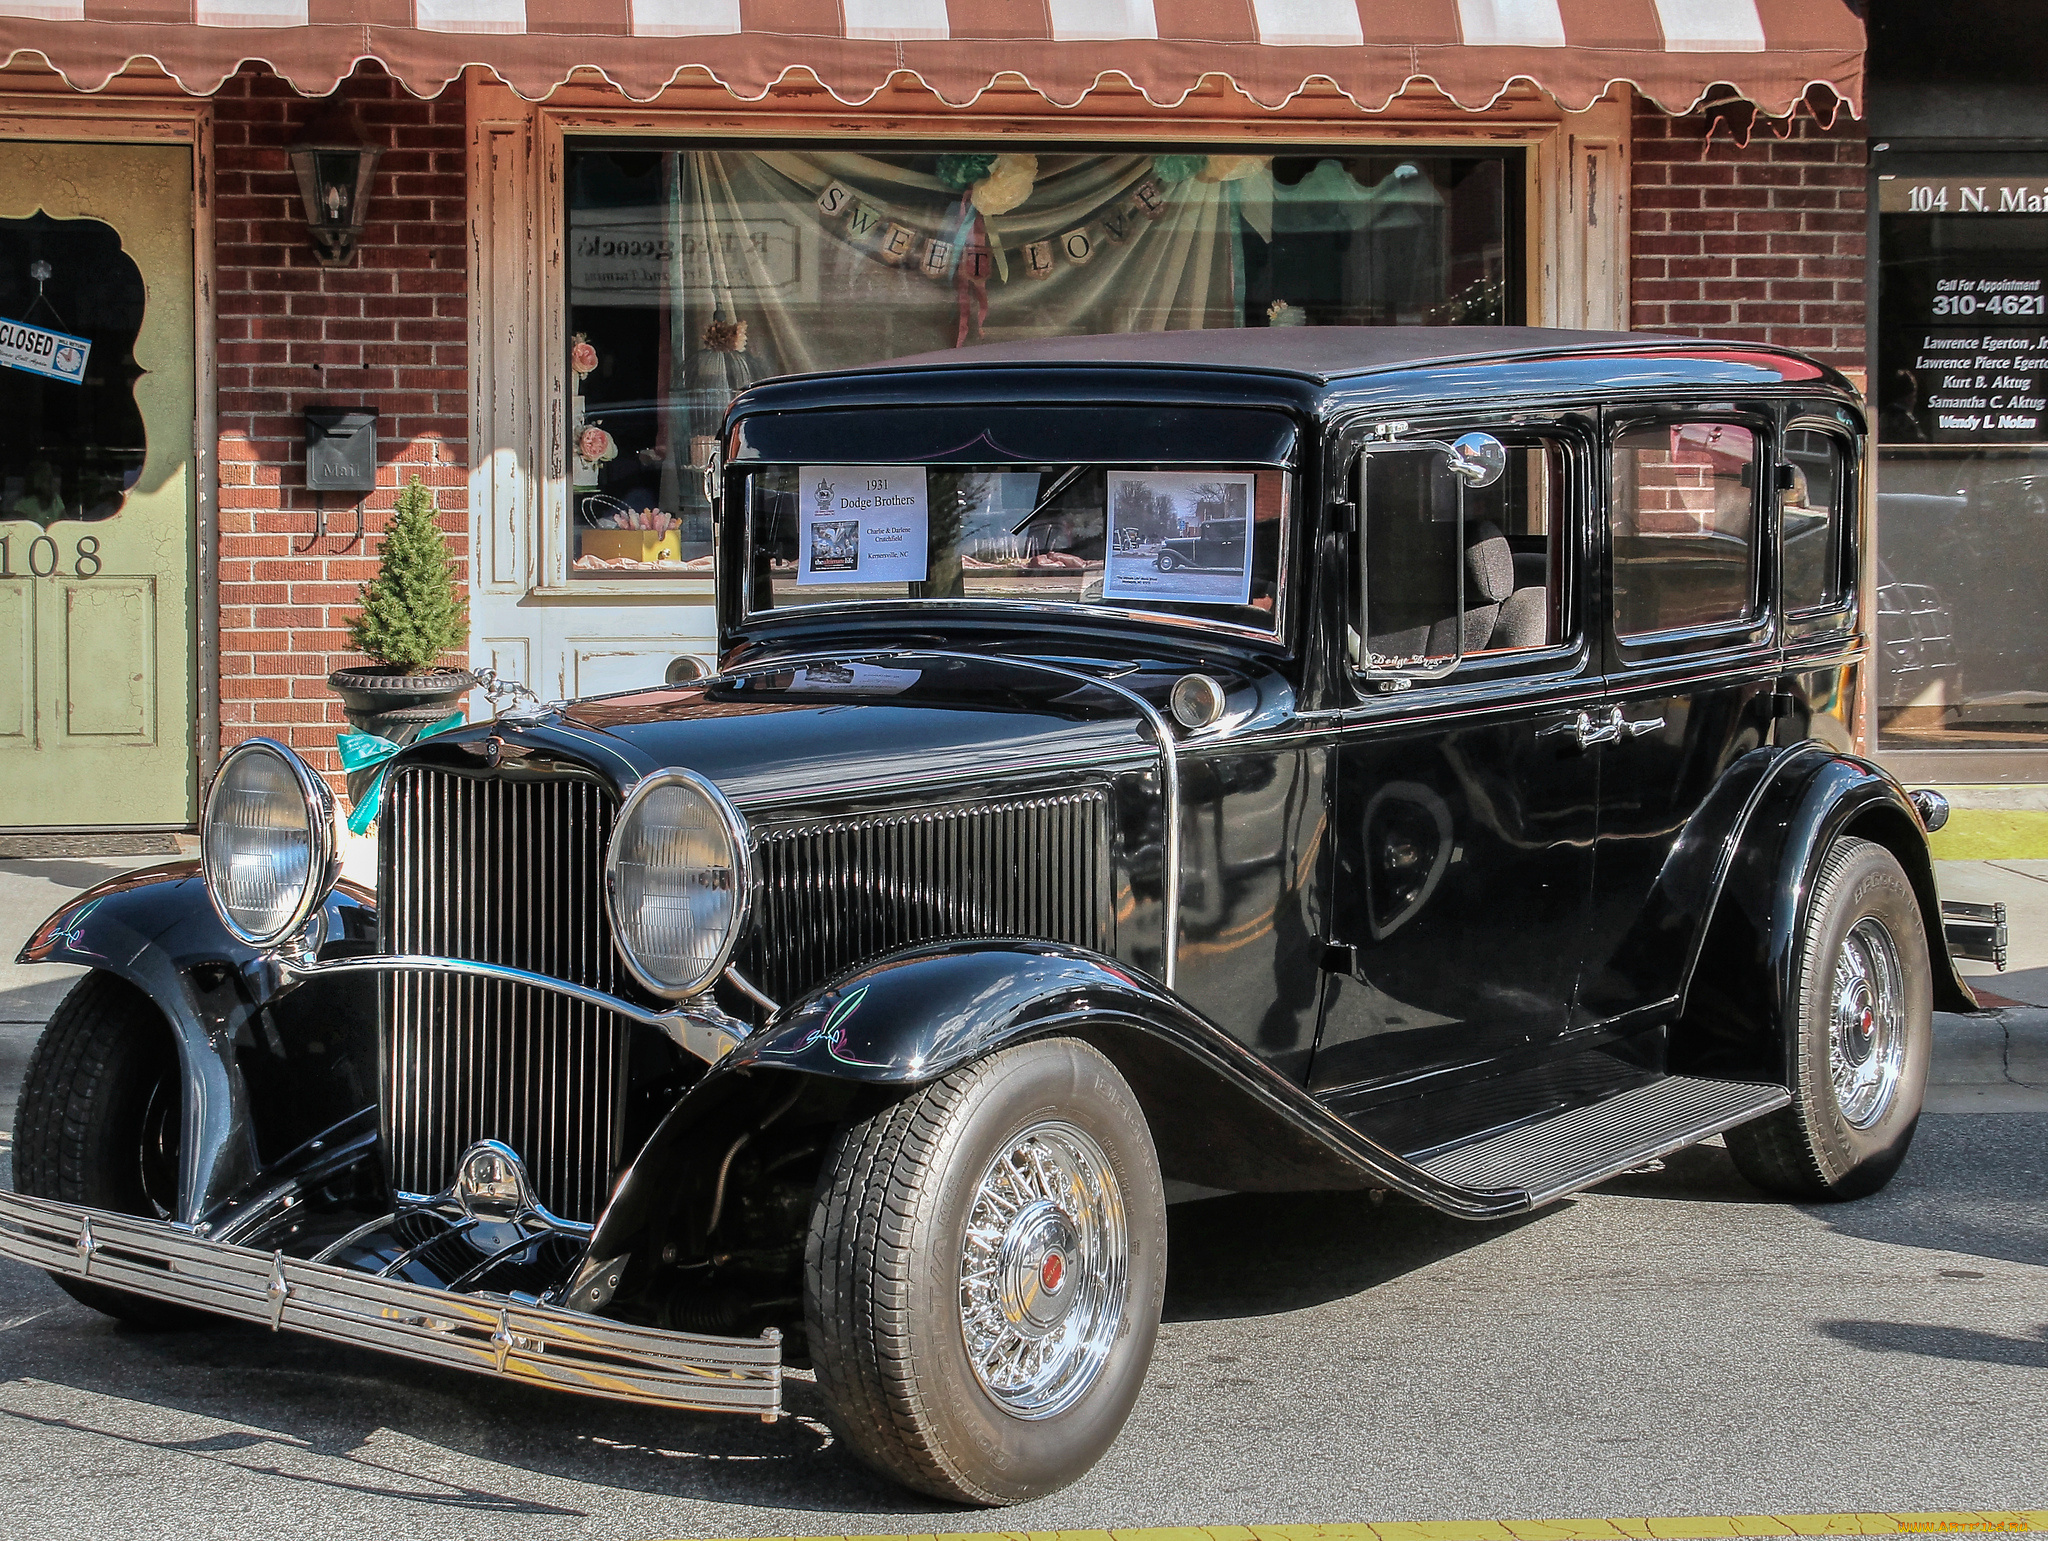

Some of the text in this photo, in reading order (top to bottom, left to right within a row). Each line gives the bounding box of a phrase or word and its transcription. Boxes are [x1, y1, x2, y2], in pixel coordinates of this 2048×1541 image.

[1908, 186, 1949, 212] 104
[1958, 187, 1990, 212] N.
[821, 184, 1162, 277] SWEET LOVE
[1936, 279, 2041, 293] Call For Appointment
[1932, 295, 2045, 315] 310-4621
[0, 324, 53, 356] CLOSED
[1923, 336, 1980, 349] Lawrence
[1915, 356, 1971, 369] Lawrence
[1974, 356, 2011, 369] Pierce
[1942, 375, 2032, 391] Kurt B. Aktug
[1927, 395, 2046, 411] Samantha C. Aktug
[1939, 414, 2037, 431] Wendy L. Nolan
[323, 462, 360, 477] Mail
[866, 479, 888, 490] 1931
[840, 495, 915, 510] Dodge Brothers
[0, 535, 102, 578] 108
[1370, 653, 1408, 669] Dodge
